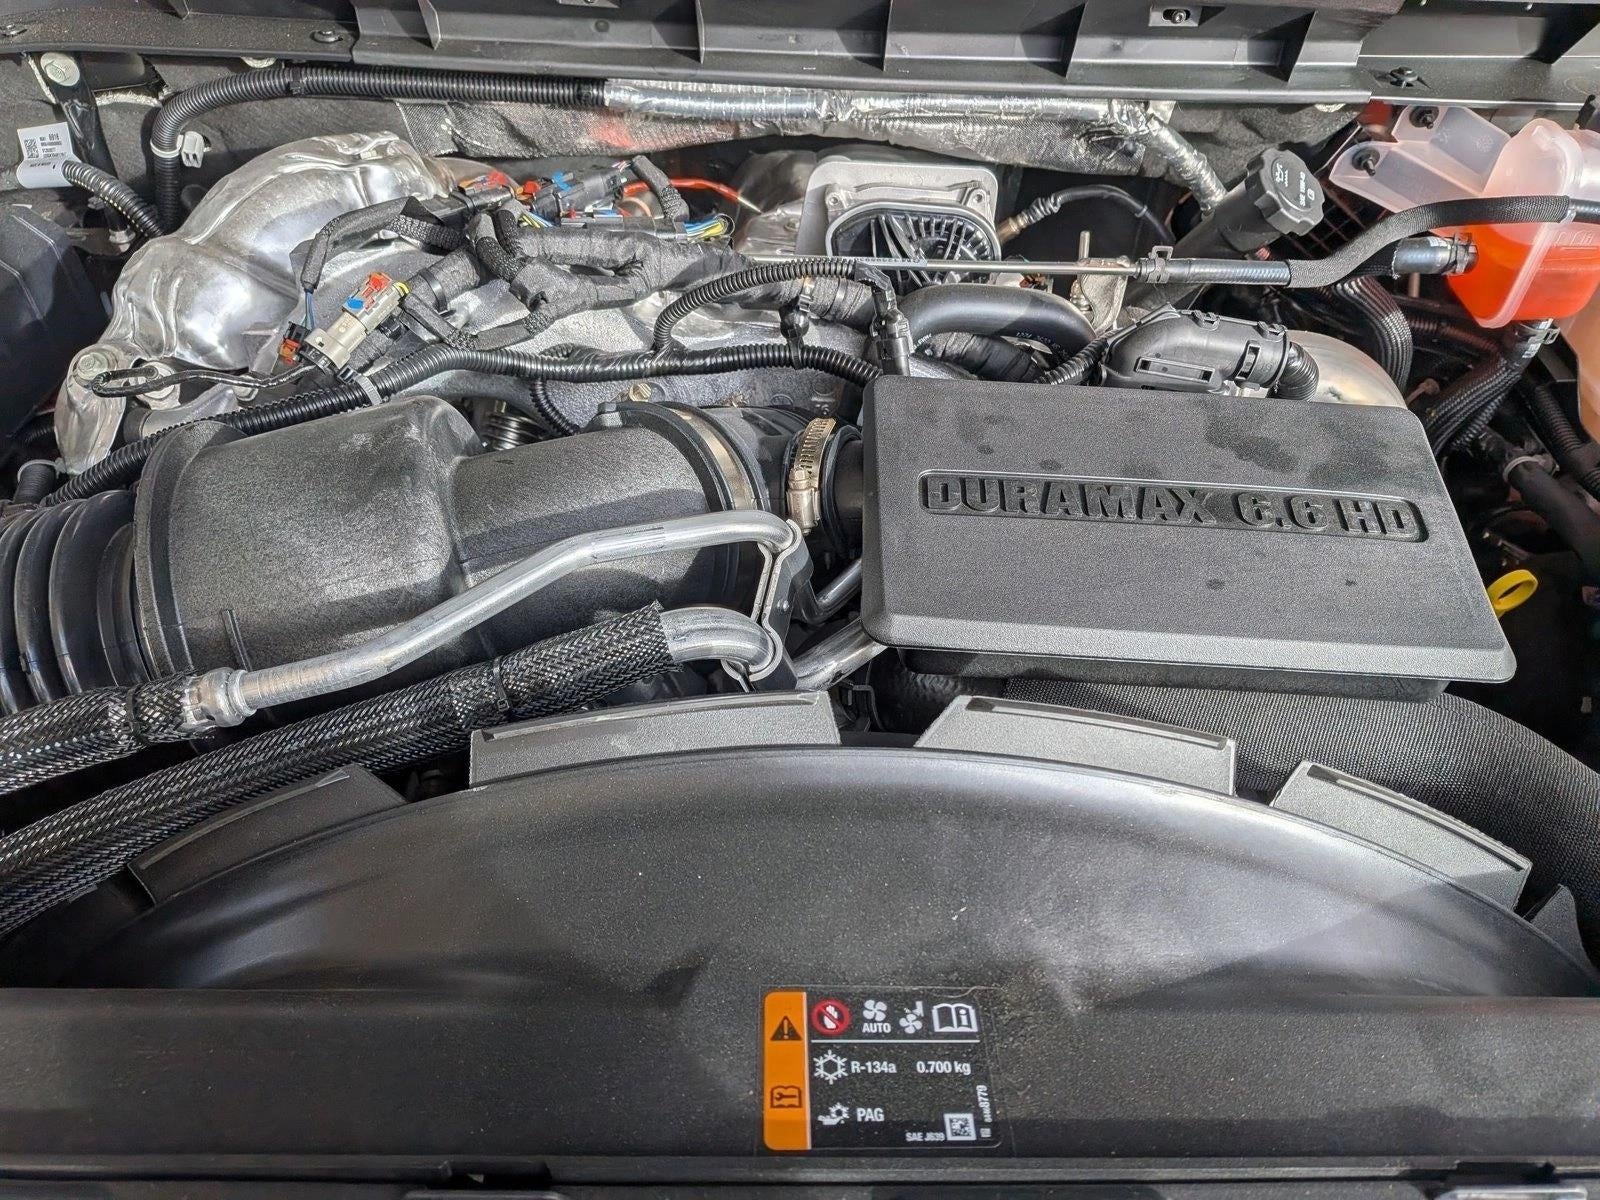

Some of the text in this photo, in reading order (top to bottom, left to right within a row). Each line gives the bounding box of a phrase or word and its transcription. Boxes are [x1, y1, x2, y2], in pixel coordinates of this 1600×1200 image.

[926, 476, 1422, 540] DURAMAX 6.6 HD
[862, 1022, 891, 1034] AUTO
[851, 1061, 972, 1075] R-134a 0.700 kg
[856, 1107, 885, 1122] PAG
[905, 1132, 924, 1142] SAE
